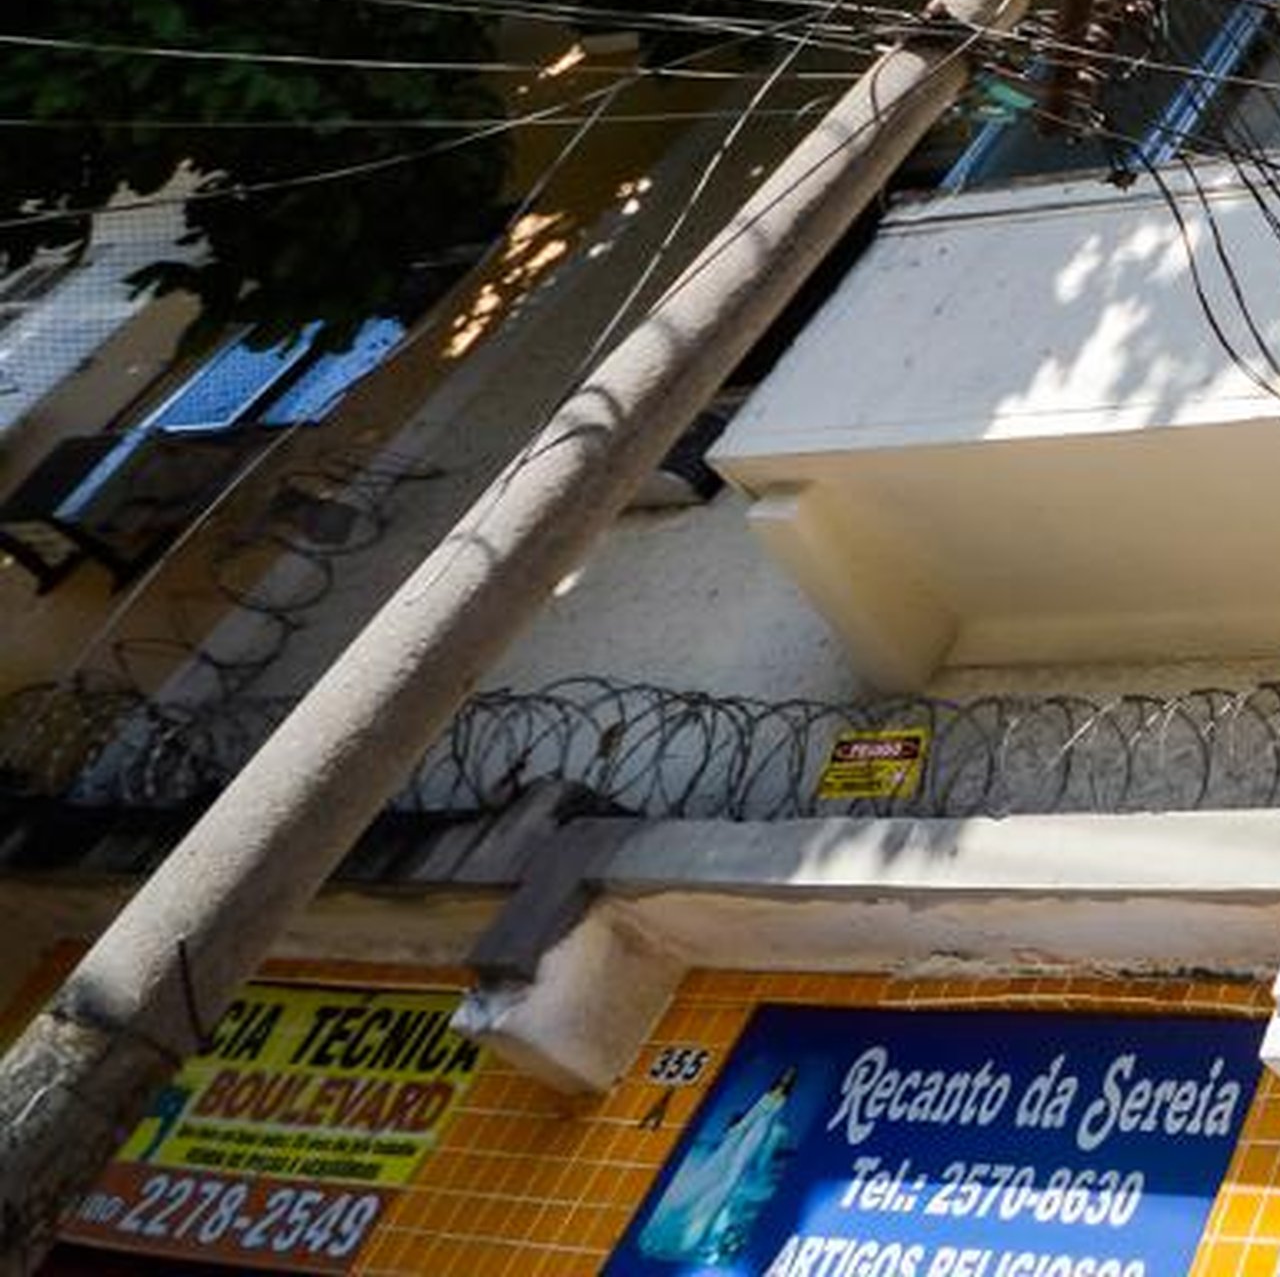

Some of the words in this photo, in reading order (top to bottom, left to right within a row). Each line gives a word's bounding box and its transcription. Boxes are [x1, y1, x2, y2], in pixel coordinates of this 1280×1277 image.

[193, 1068, 454, 1134] BOULEVARD
[828, 1046, 1012, 1146] Recanto
[1017, 1053, 1078, 1129] da
[1076, 1053, 1242, 1152] Sereia
[116, 1175, 384, 1257] 2278-2549
[838, 1155, 929, 1213] Tel.:
[923, 1161, 1146, 1226] 2570-8630
[761, 1234, 925, 1277] ARTIGOS
